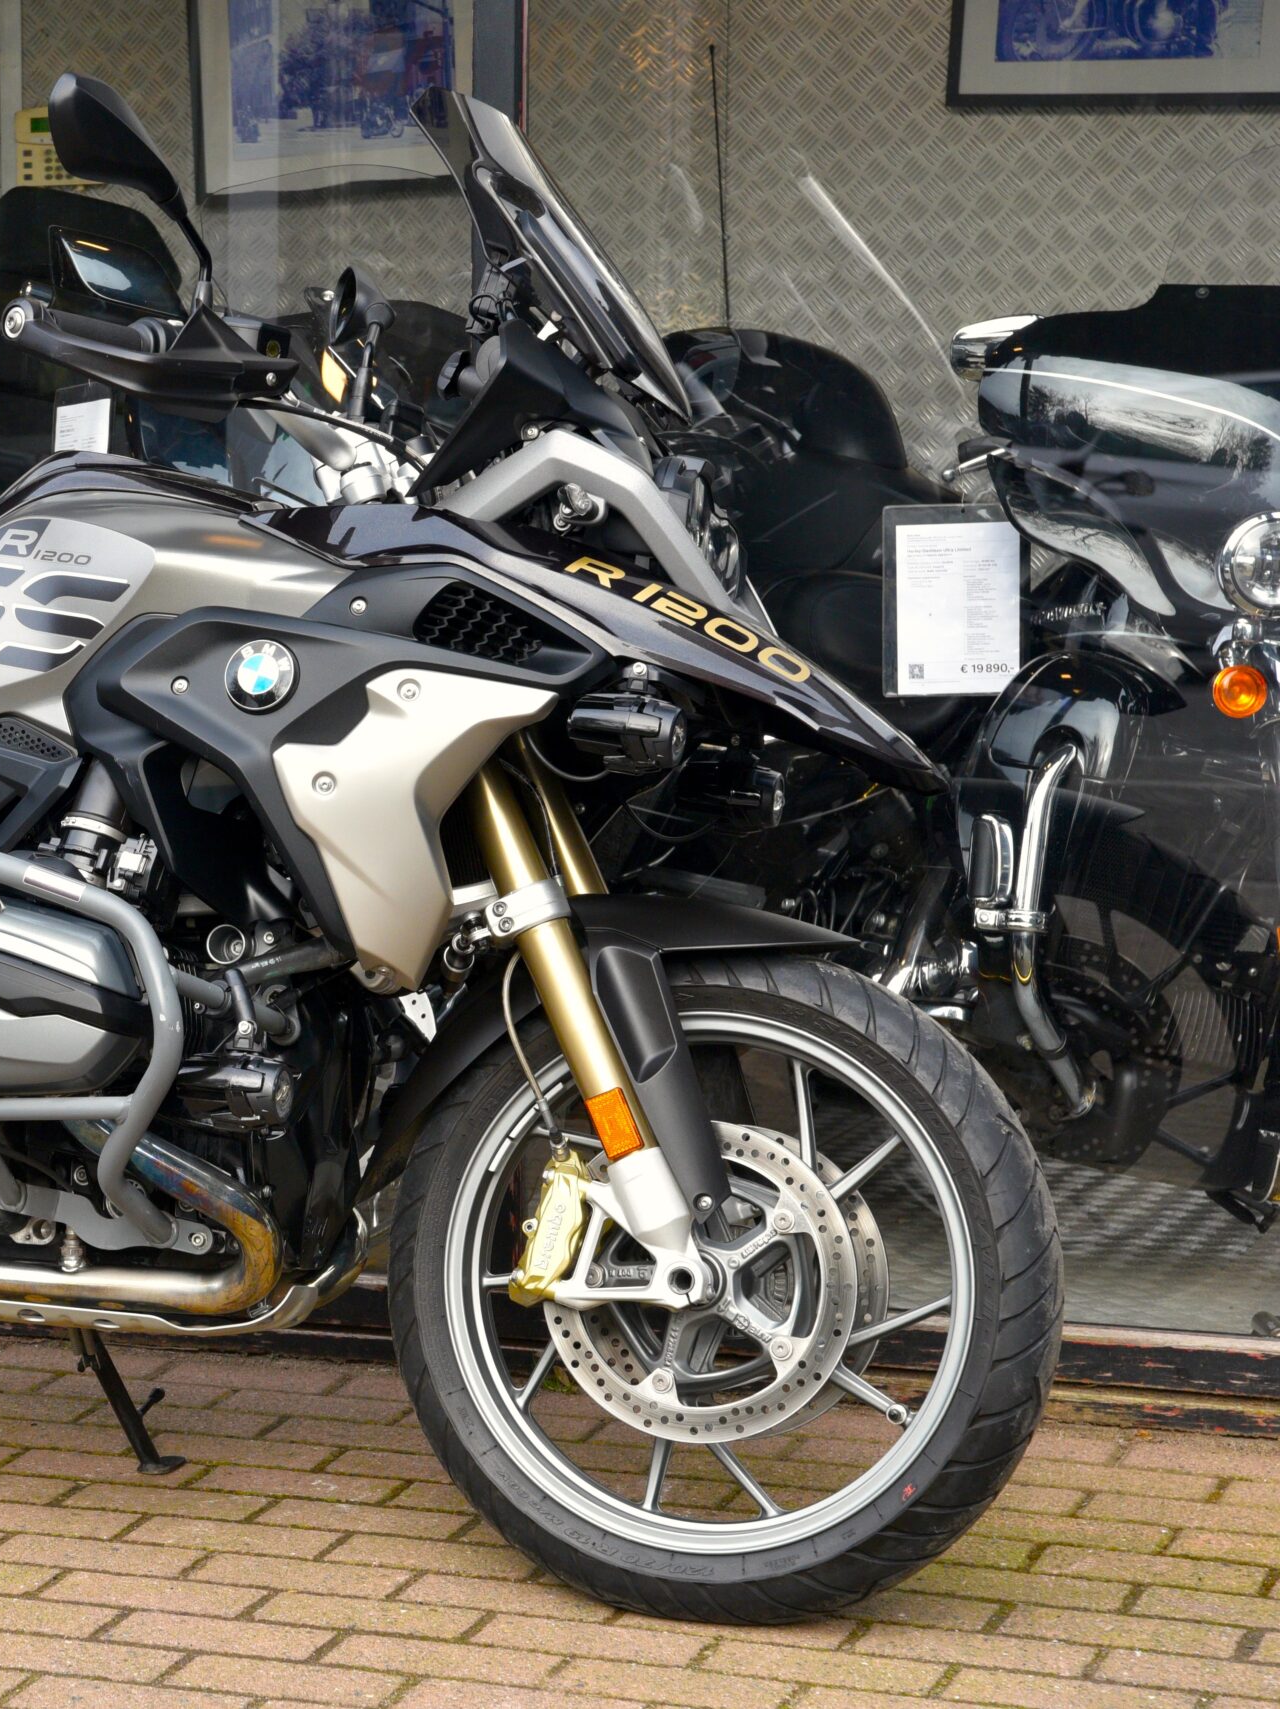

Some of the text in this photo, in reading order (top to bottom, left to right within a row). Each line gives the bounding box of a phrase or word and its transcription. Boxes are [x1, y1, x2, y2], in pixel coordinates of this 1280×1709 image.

[32, 549, 91, 566] 1200
[564, 556, 811, 683] R 1200
[241, 643, 291, 671] BMW
[533, 1203, 567, 1271] brembo
